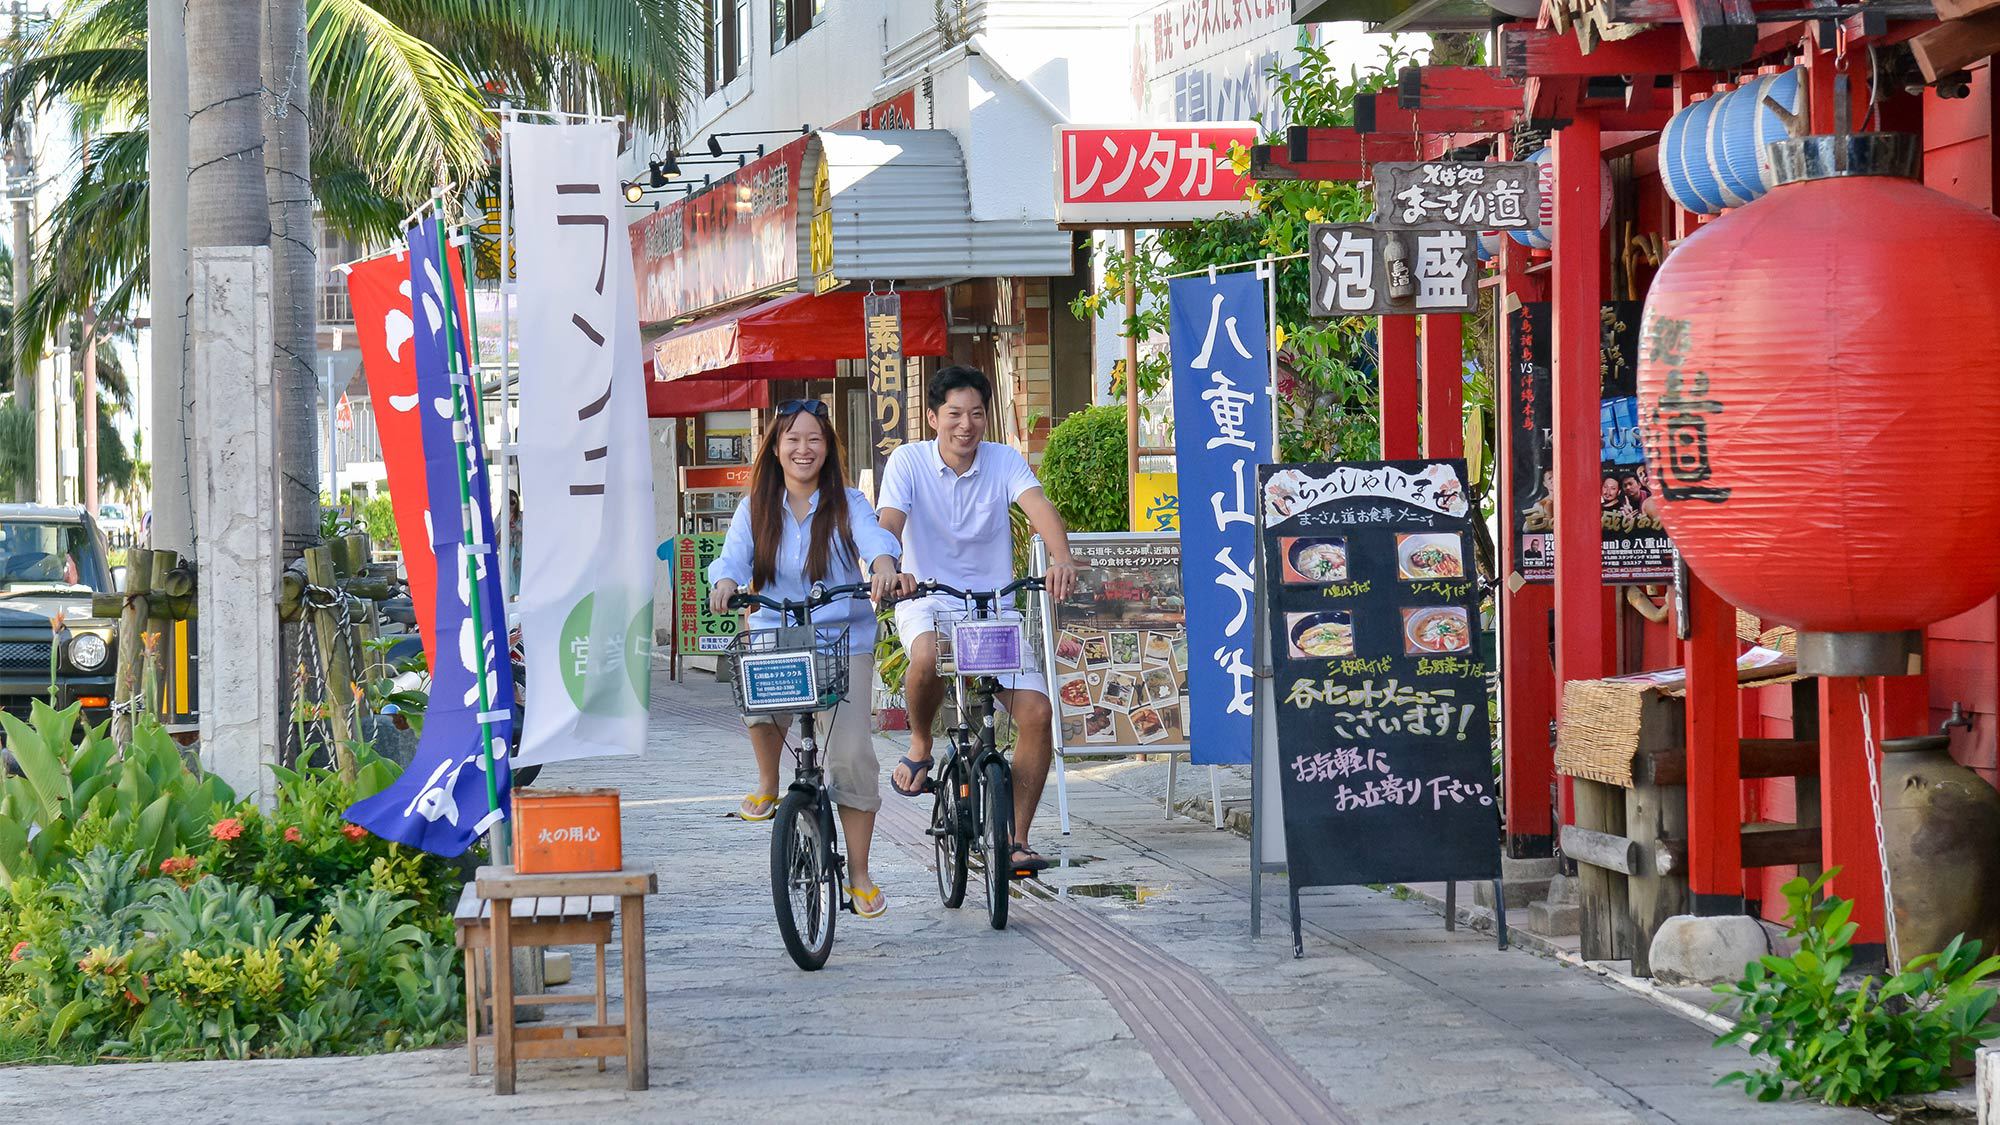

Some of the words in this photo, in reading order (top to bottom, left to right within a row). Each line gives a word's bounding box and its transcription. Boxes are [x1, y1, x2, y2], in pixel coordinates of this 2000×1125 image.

[1068, 131, 1250, 198] レンタカー
[1423, 164, 1485, 186] そば処
[1397, 180, 1528, 226] まーさん道
[1321, 231, 1468, 311] 泡盛
[1520, 362, 1533, 374] VS
[1648, 369, 1732, 503] 道
[1190, 293, 1256, 716] 八重山そば
[1272, 469, 1457, 516] いらっしゃいませ
[1090, 557, 1179, 567] 島の食材をイタリアンで
[1416, 657, 1486, 678] 島野菜すば
[1284, 678, 1455, 709] 各セットメニュー
[1291, 747, 1391, 783] お気軽に
[538, 826, 601, 844] 火の用心
